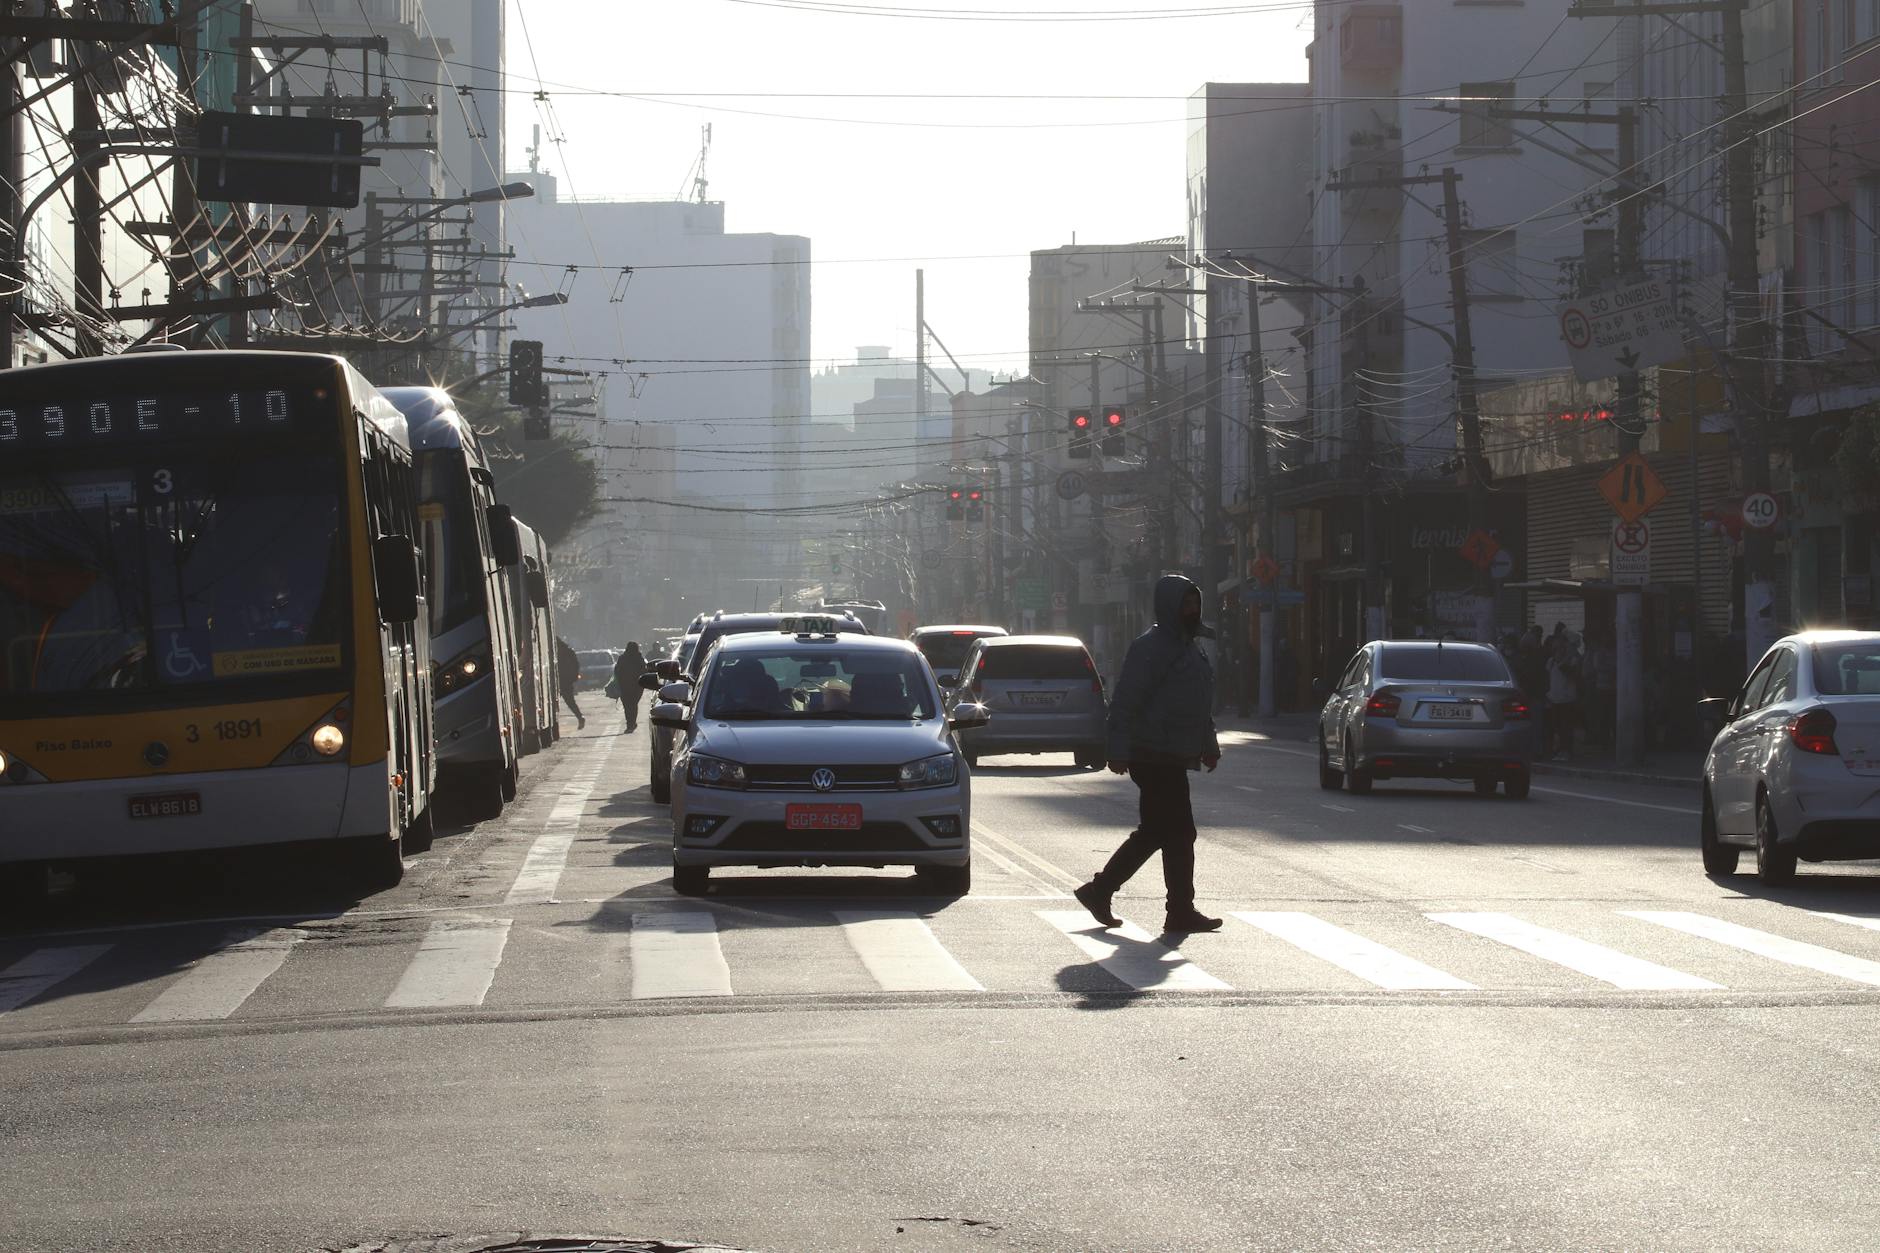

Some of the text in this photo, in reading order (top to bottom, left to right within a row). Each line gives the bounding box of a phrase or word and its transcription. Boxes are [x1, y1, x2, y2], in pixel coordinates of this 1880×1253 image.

[153, 469, 174, 494] 3
[1746, 499, 1774, 517] 40
[803, 618, 833, 633] TAXI
[185, 717, 262, 744] 3 1891
[36, 738, 112, 753] Piso Baixo
